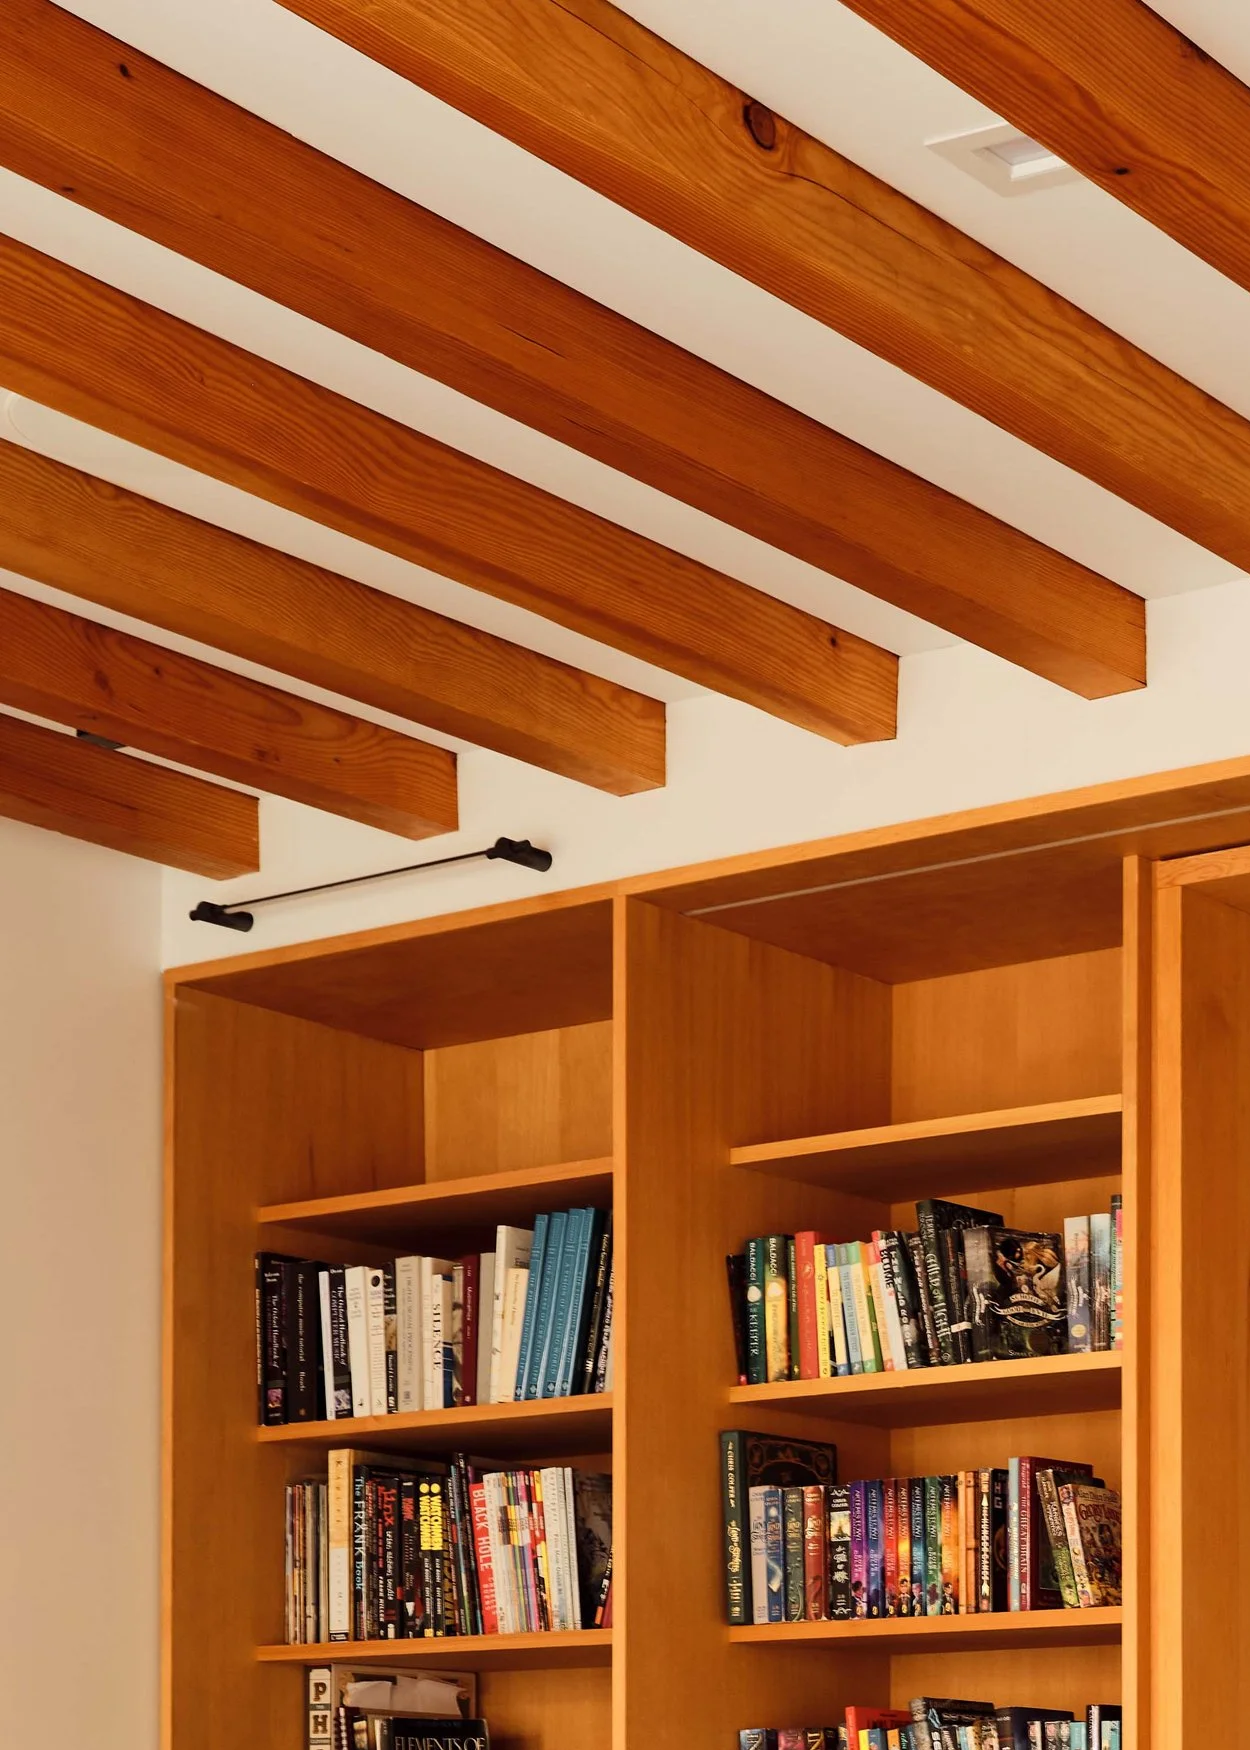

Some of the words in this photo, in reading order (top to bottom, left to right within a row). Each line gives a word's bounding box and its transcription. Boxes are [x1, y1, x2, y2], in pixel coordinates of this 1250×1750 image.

[769, 1238, 777, 1276] BALDACCI
[433, 1303, 442, 1370] SILENCE
[749, 1315, 759, 1356] KEEPER
[354, 1477, 364, 1496] The
[420, 1495, 432, 1550] WATCHMEN
[431, 1495, 443, 1550] WATCHMEN
[472, 1489, 489, 1527] BLACK
[478, 1537, 493, 1571] HOLE
[1020, 1545, 1028, 1574] BRAIN
[355, 1560, 364, 1589] Book
